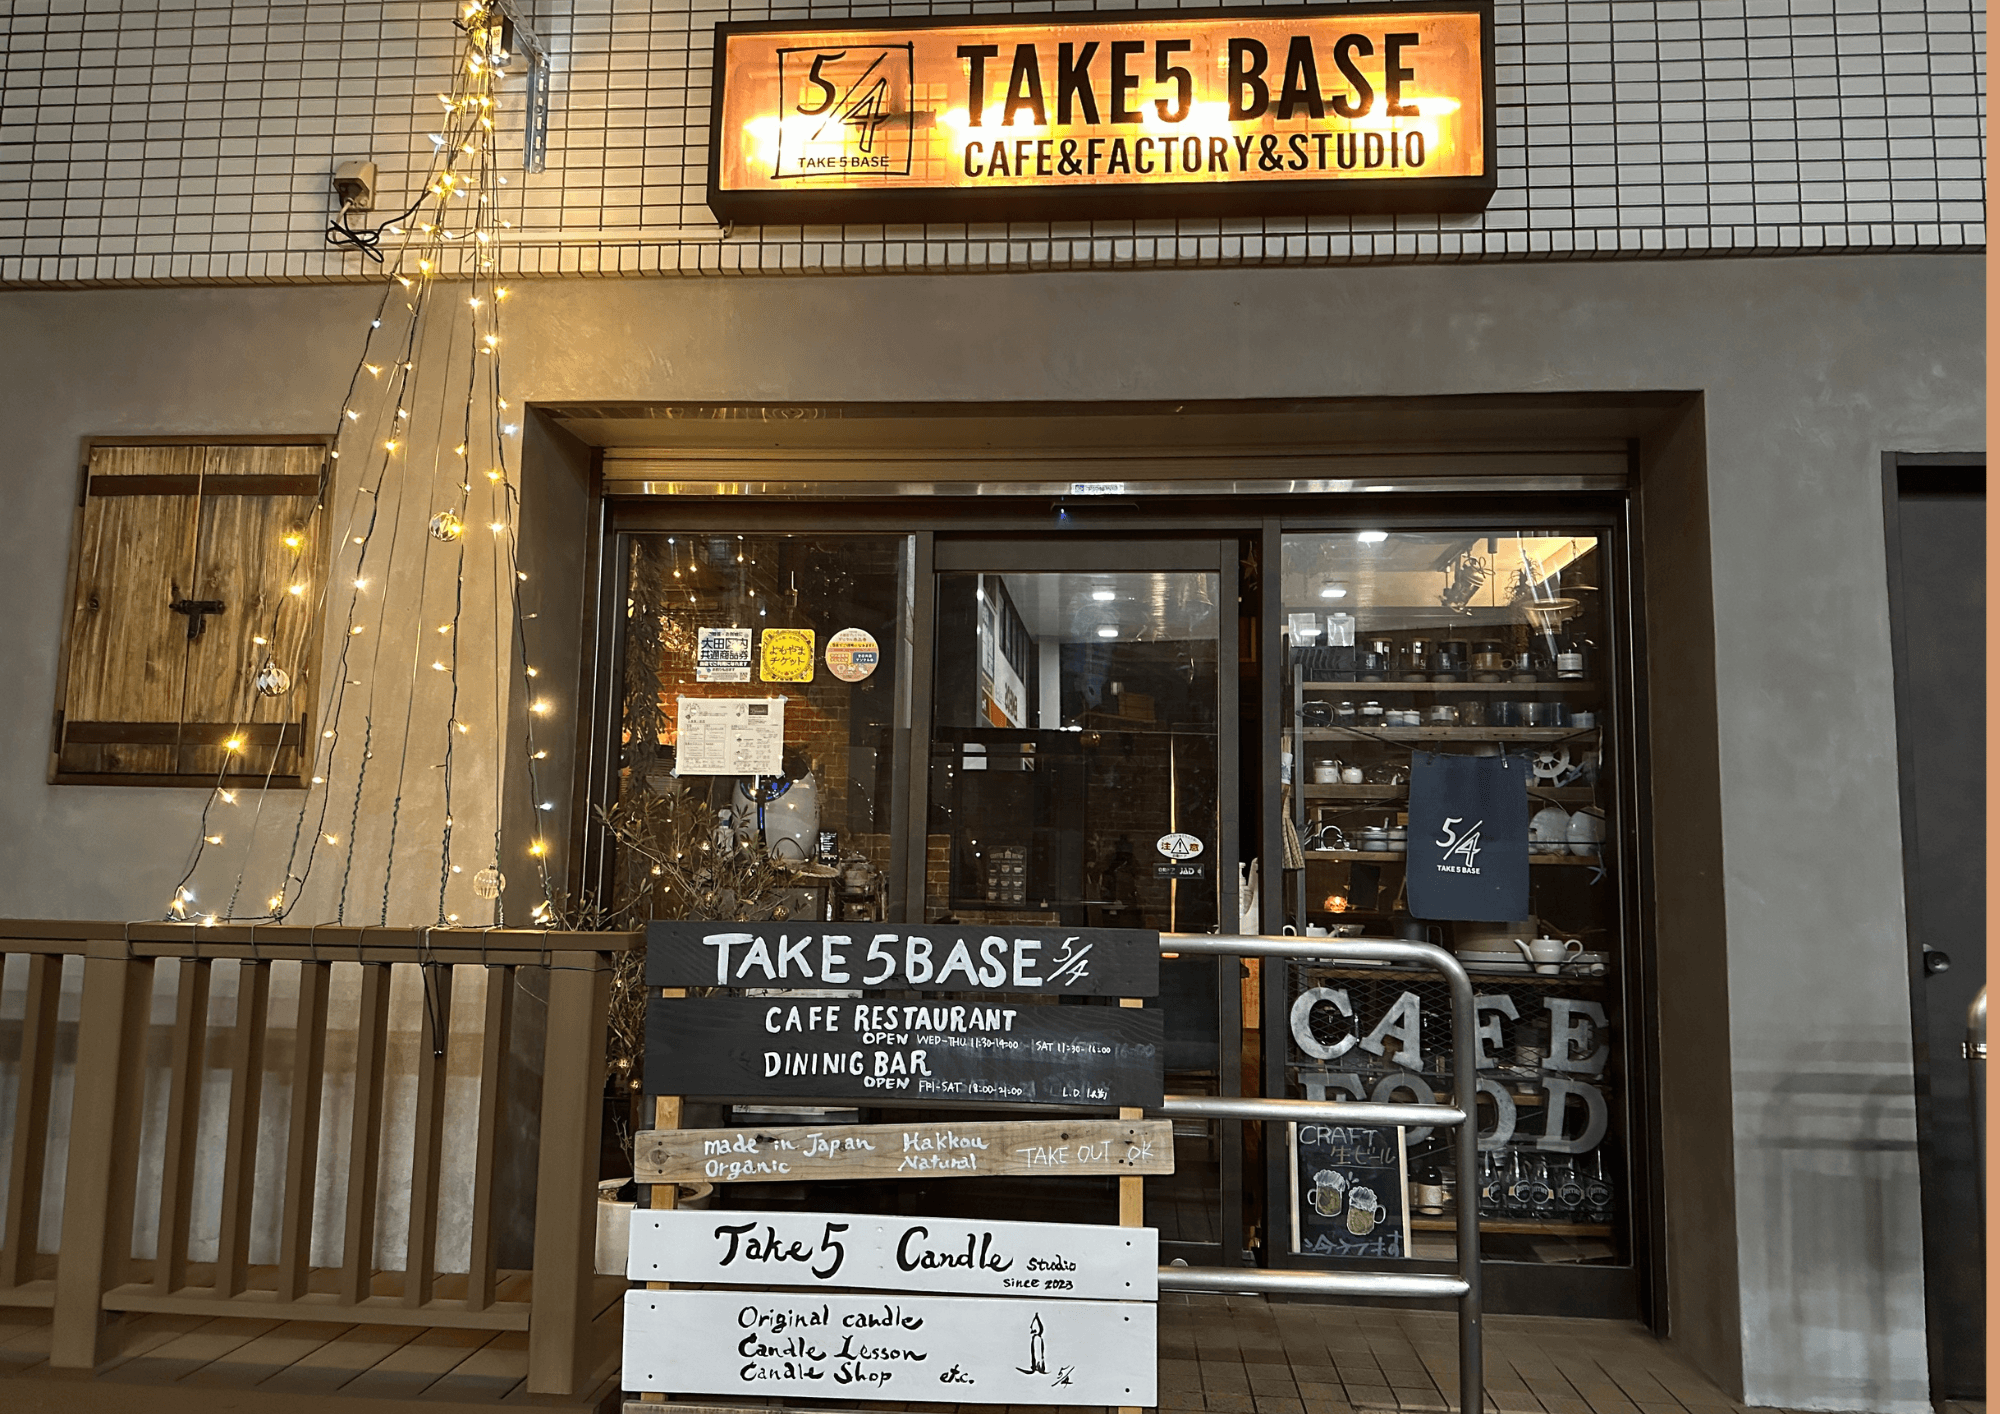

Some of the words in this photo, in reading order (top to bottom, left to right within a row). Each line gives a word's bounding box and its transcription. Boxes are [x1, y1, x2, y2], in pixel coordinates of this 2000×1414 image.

[957, 39, 1192, 127] TAKE5
[1227, 33, 1421, 121] BASE
[798, 157, 836, 168] TAKE
[839, 156, 848, 168] 5
[851, 156, 890, 168] BASE
[964, 131, 1426, 177] CAFE&FACTORY&STUDIO
[770, 656, 805, 666] チケット
[1437, 865, 1456, 873] TAKE
[1462, 867, 1481, 875] BASE
[702, 933, 852, 985] TAKE
[862, 934, 899, 984] 5
[906, 935, 1043, 988] BASE
[765, 1005, 840, 1033] CAFE
[854, 1004, 1017, 1033] RESTAURANT
[863, 1031, 909, 1045] OPEN
[1035, 1040, 1054, 1052] SAT
[764, 1051, 864, 1077] DININIG
[874, 1050, 932, 1077] BAR
[863, 1076, 910, 1090] OPEN
[704, 1133, 760, 1156] made
[773, 1139, 798, 1151] in
[803, 1132, 876, 1159] Japan
[903, 1130, 990, 1153] Hakkou
[1016, 1146, 1068, 1168] TAKE
[1077, 1139, 1114, 1164] OUT
[1127, 1141, 1154, 1161] OK
[1300, 1125, 1378, 1147] CRAFT
[705, 1159, 791, 1180] Organic
[898, 1152, 977, 1171] Natural
[1330, 1145, 1397, 1165] 生ビール
[714, 1222, 813, 1267] Take
[811, 1222, 849, 1279] 5
[896, 1226, 1014, 1273] Candle
[1026, 1254, 1077, 1272] Studio
[1003, 1278, 1040, 1289] since
[1044, 1279, 1074, 1290] 2023
[738, 1303, 829, 1333] Original
[842, 1304, 924, 1331] candle
[738, 1332, 827, 1360] Candle
[833, 1334, 928, 1362] Lesson
[739, 1361, 825, 1382] Candle
[833, 1361, 892, 1388] Shop
[939, 1363, 975, 1385] etc.
